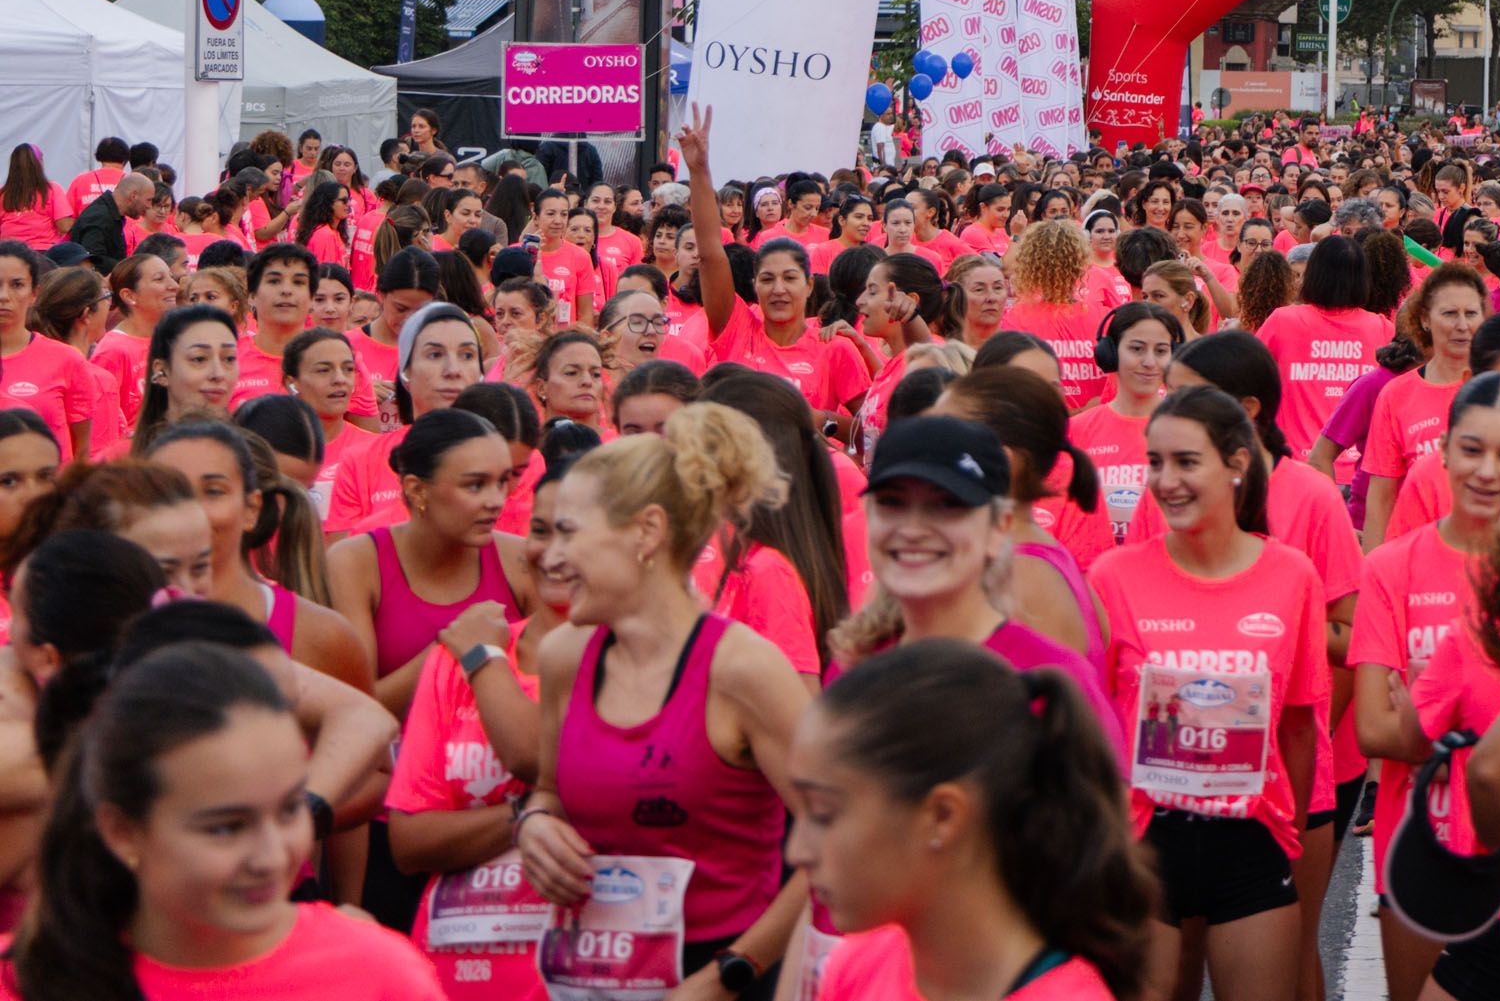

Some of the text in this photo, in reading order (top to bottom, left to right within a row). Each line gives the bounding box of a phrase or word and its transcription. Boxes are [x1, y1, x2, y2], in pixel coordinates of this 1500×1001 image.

[207, 38, 236, 47] FUERA DE
[204, 50, 239, 60] LOS LÍMITES
[584, 55, 637, 69] OYSHO
[706, 41, 831, 81] OYSHO
[204, 63, 238, 73] MARCADOS
[1108, 69, 1148, 84] Sports
[507, 85, 640, 105] CORREDORAS
[1103, 89, 1165, 104] Santander
[1311, 340, 1363, 360] SOMOS
[1325, 387, 1344, 397] 2026
[1138, 618, 1195, 632] OYSHO
[1179, 726, 1228, 749] 016
[471, 863, 522, 889] 016
[577, 932, 633, 959] 016
[455, 959, 491, 982] 2026
